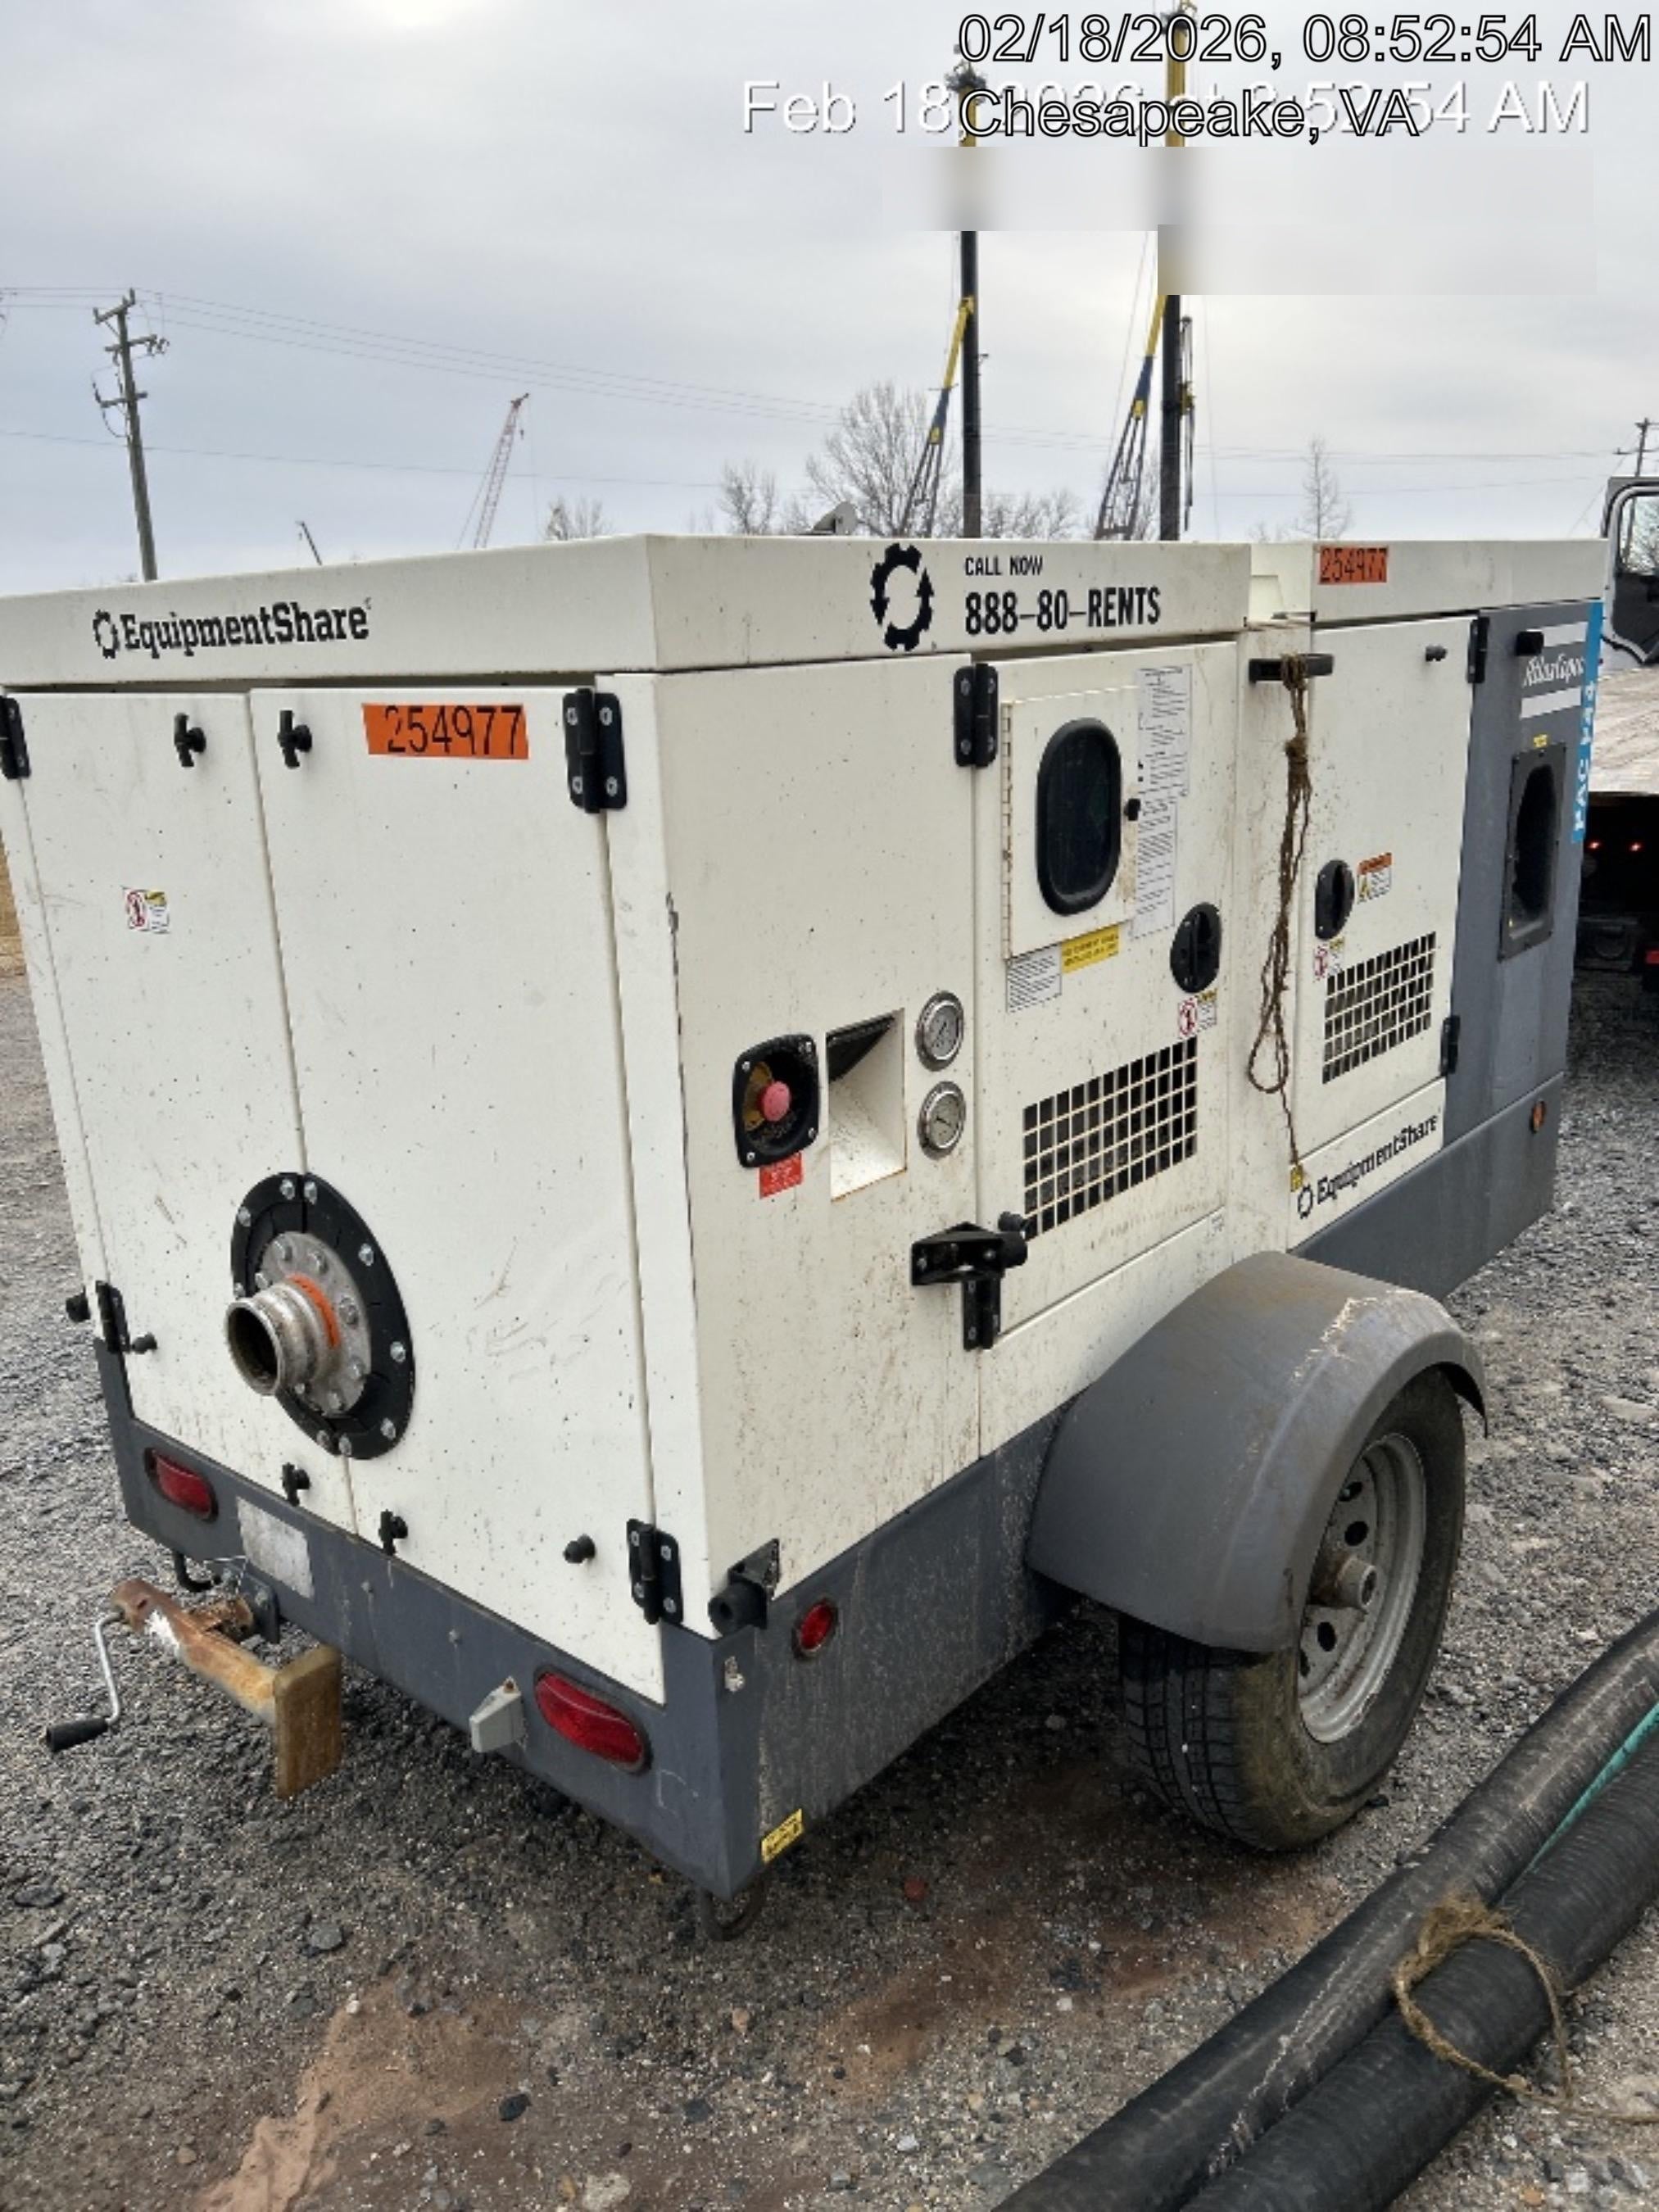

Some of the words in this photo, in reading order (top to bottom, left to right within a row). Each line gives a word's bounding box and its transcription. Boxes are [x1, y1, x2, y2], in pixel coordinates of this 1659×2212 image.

[965, 556, 1002, 576] CALL
[1009, 555, 1043, 576] NOW
[1321, 547, 1386, 582] 254977
[120, 601, 369, 660] EquipmentShare
[965, 586, 1160, 636] 888-80-RENTS
[384, 705, 521, 755] 254977
[1317, 1115, 1439, 1205] EquipmentShare
